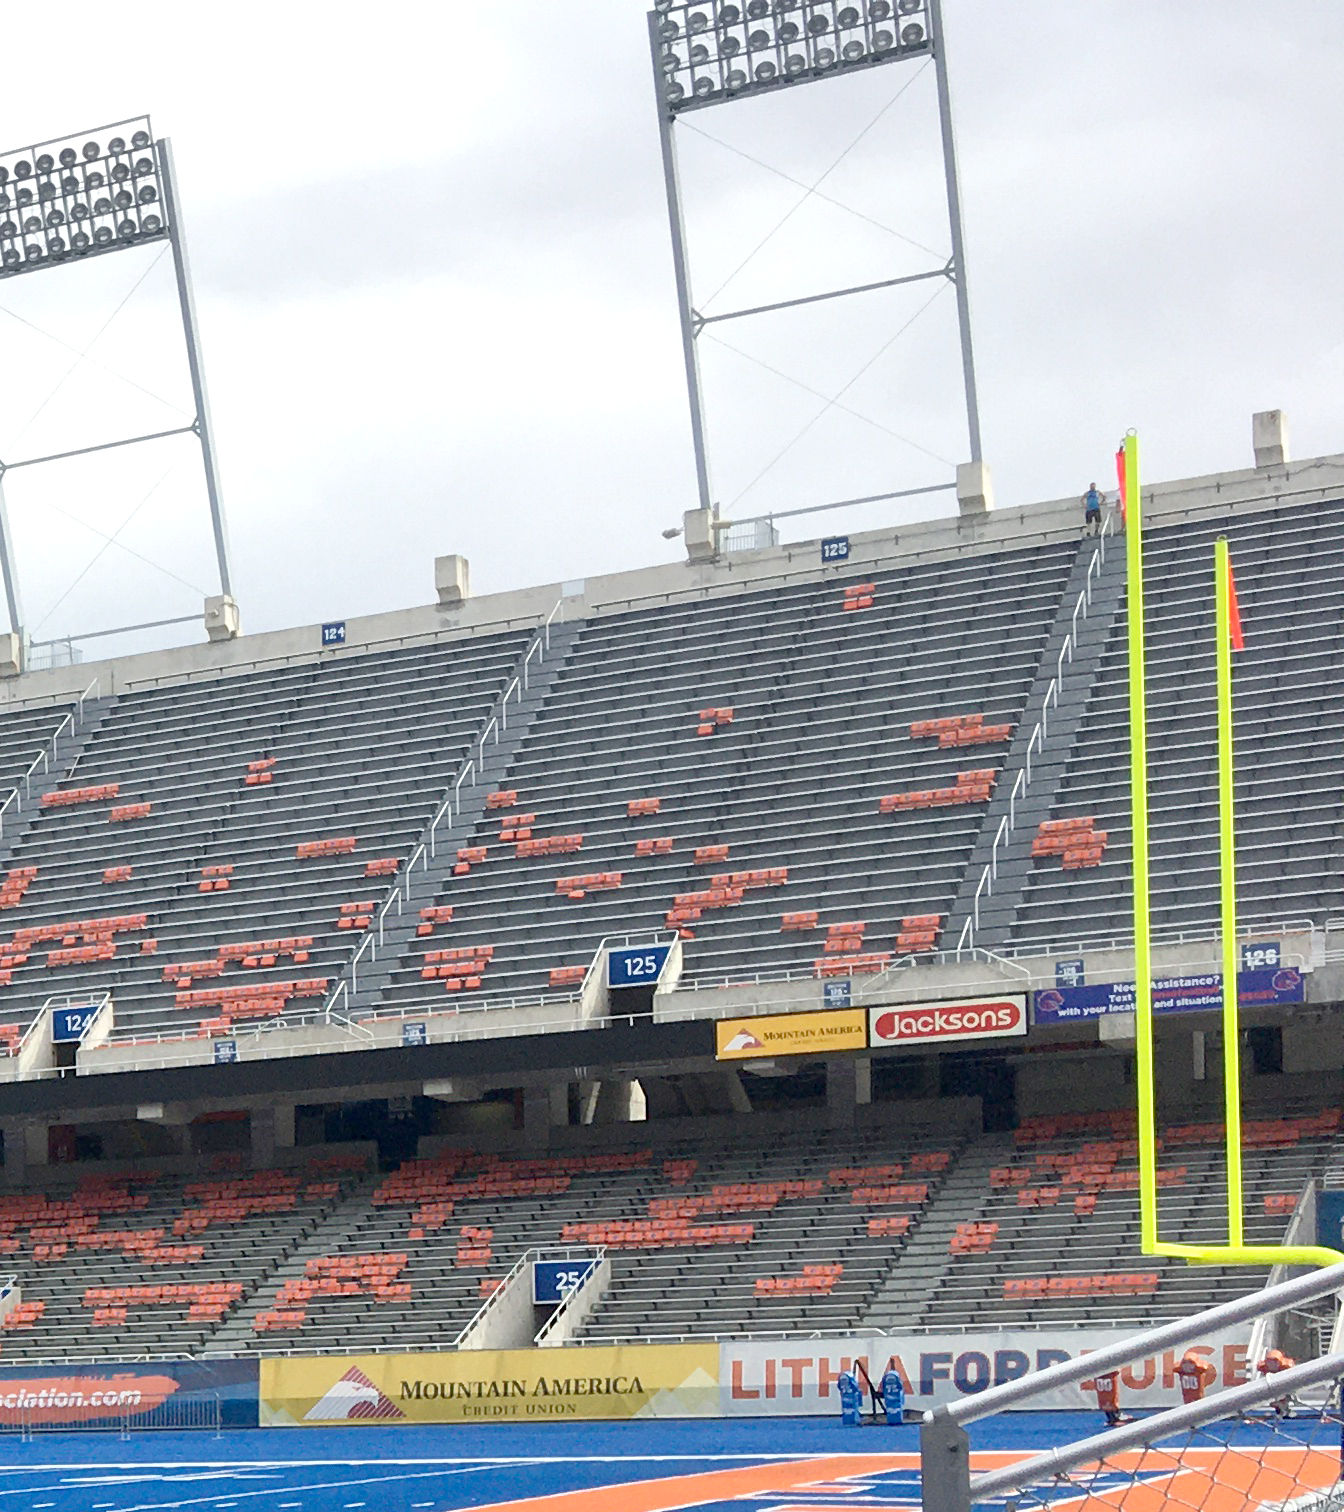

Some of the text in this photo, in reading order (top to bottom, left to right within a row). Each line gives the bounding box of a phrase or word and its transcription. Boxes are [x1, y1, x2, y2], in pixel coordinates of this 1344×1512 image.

[824, 542, 848, 558] 125
[325, 626, 345, 641] 124
[624, 955, 657, 977] 125
[885, 1008, 1012, 1039] Jacksons
[556, 1271, 580, 1290] 25
[399, 1376, 645, 1401] MOUNTAIN AMERICA
[462, 1403, 577, 1417] CREDIT UNION
